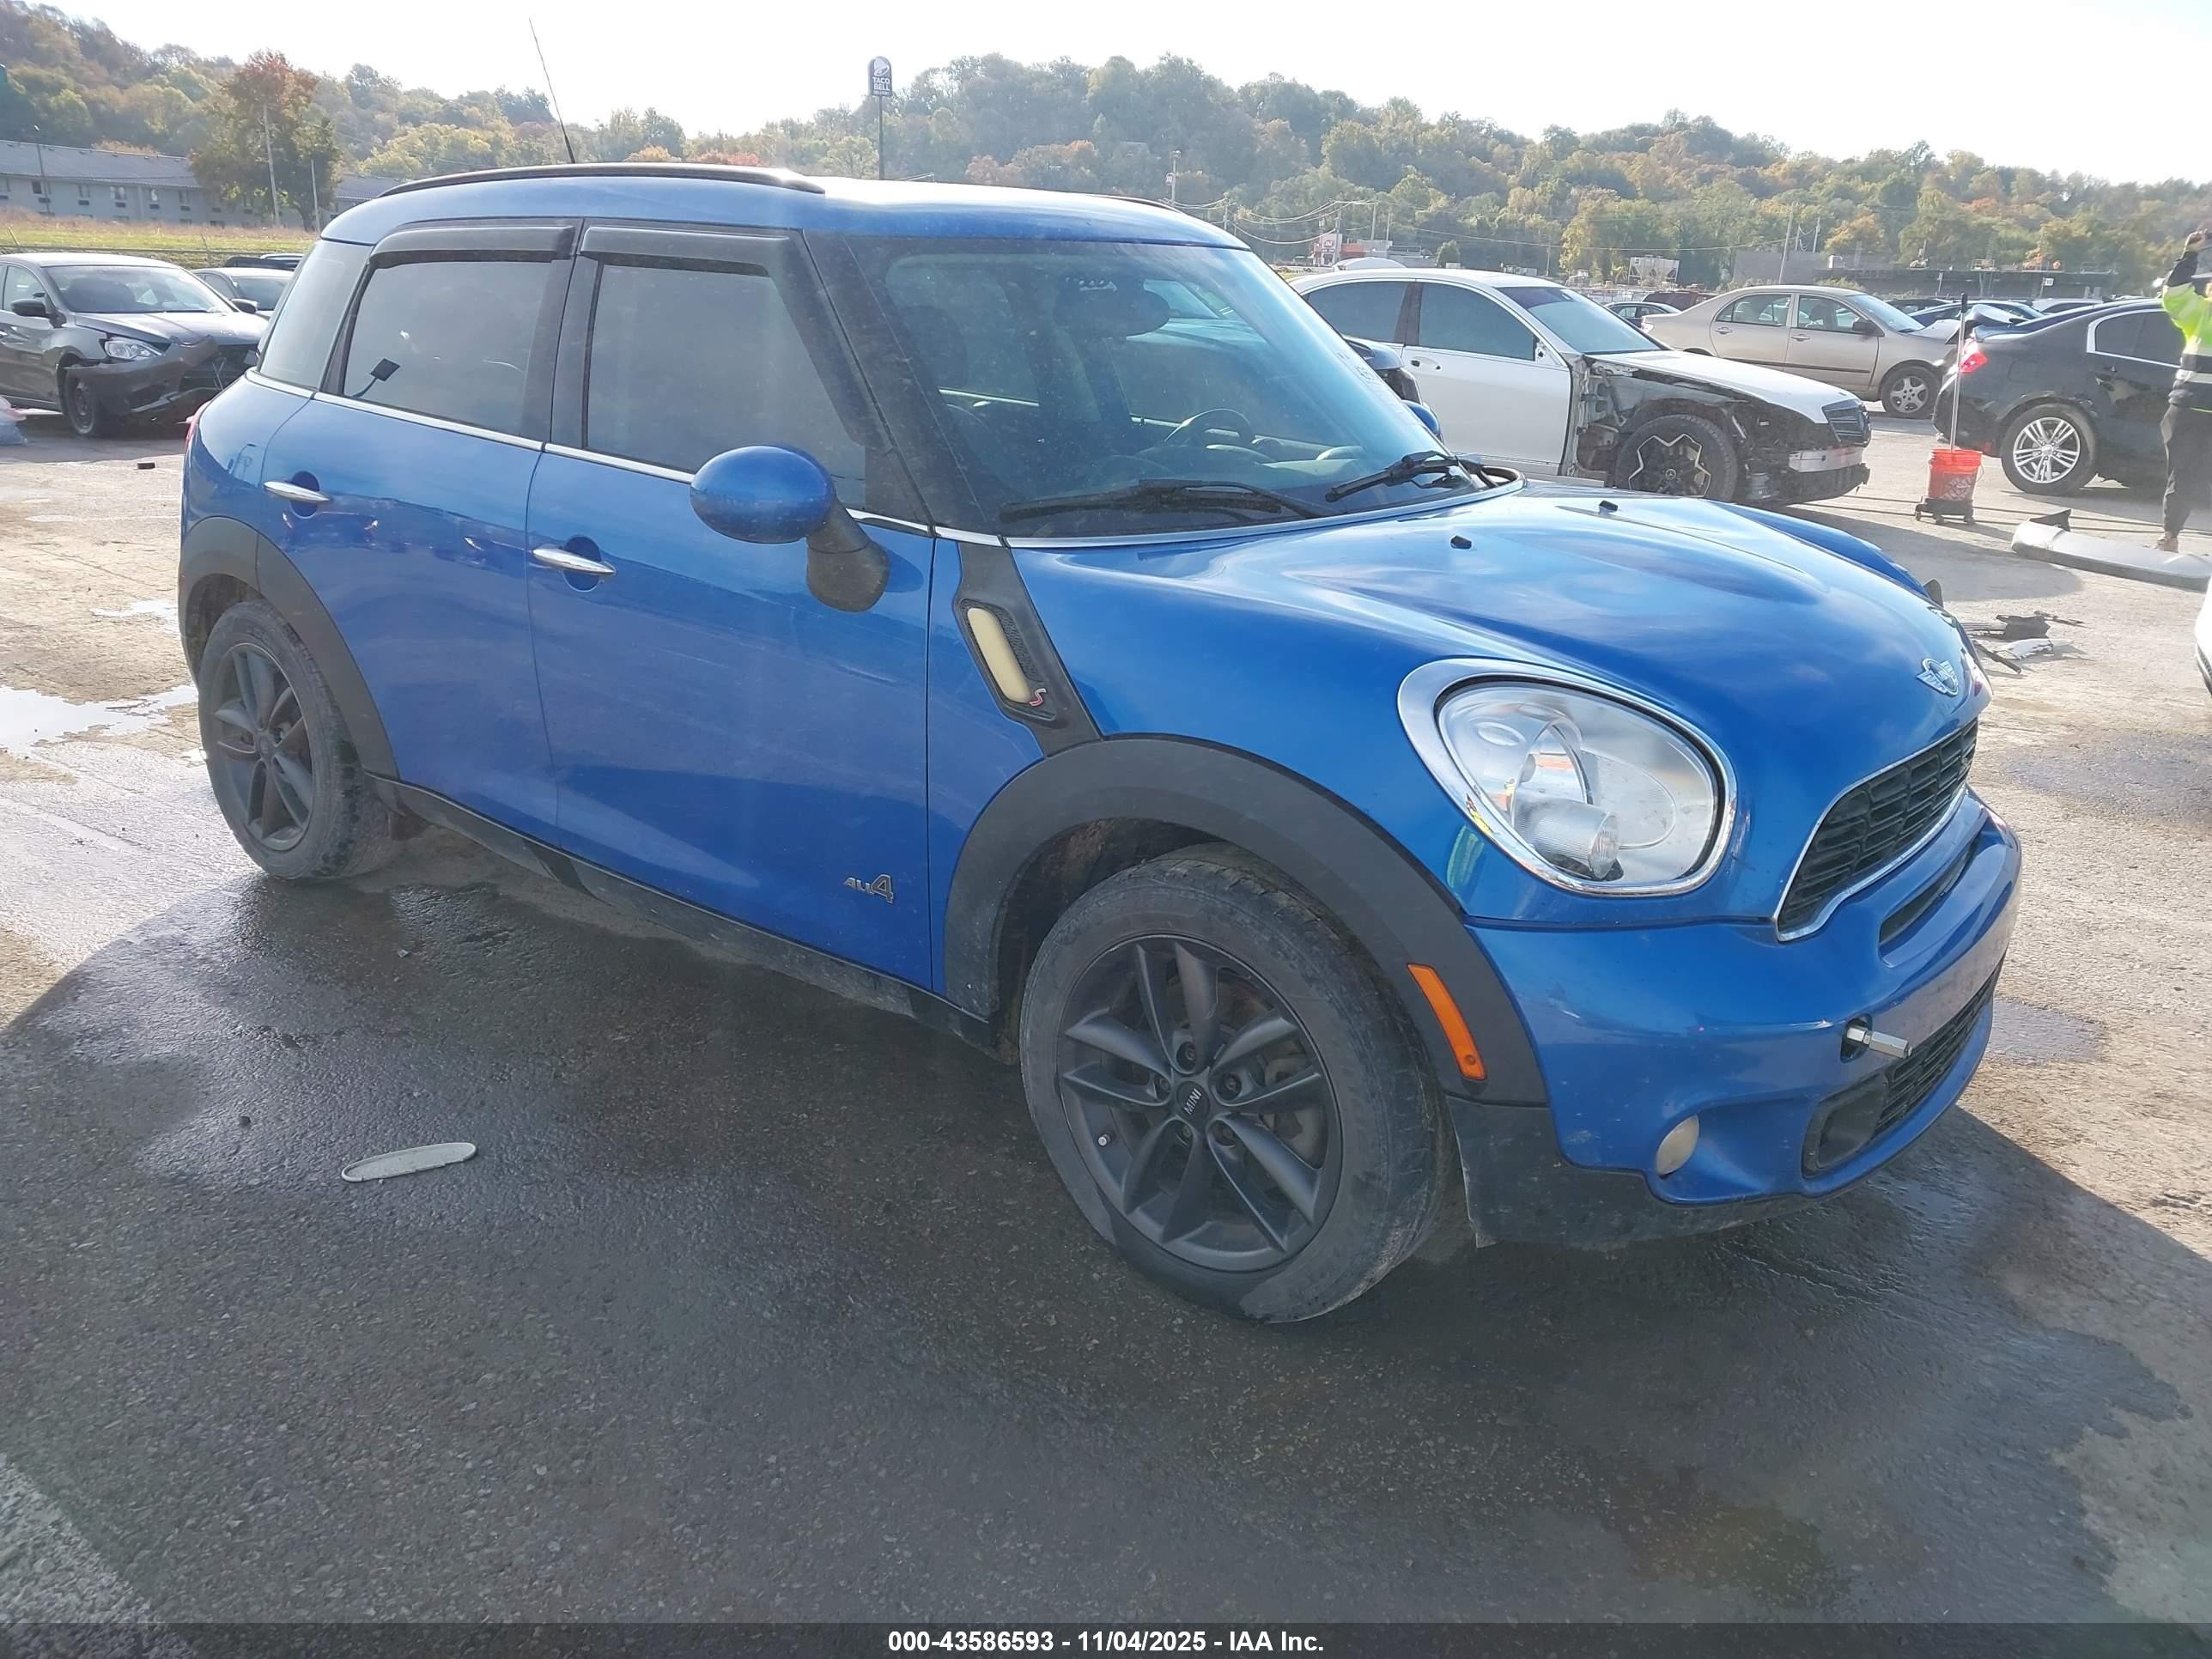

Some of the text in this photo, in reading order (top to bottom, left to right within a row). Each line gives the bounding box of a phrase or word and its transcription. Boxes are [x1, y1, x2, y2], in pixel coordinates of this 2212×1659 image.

[1029, 688, 1047, 707] S
[843, 873, 894, 904] ALL4
[1183, 1088, 1202, 1115] MINI
